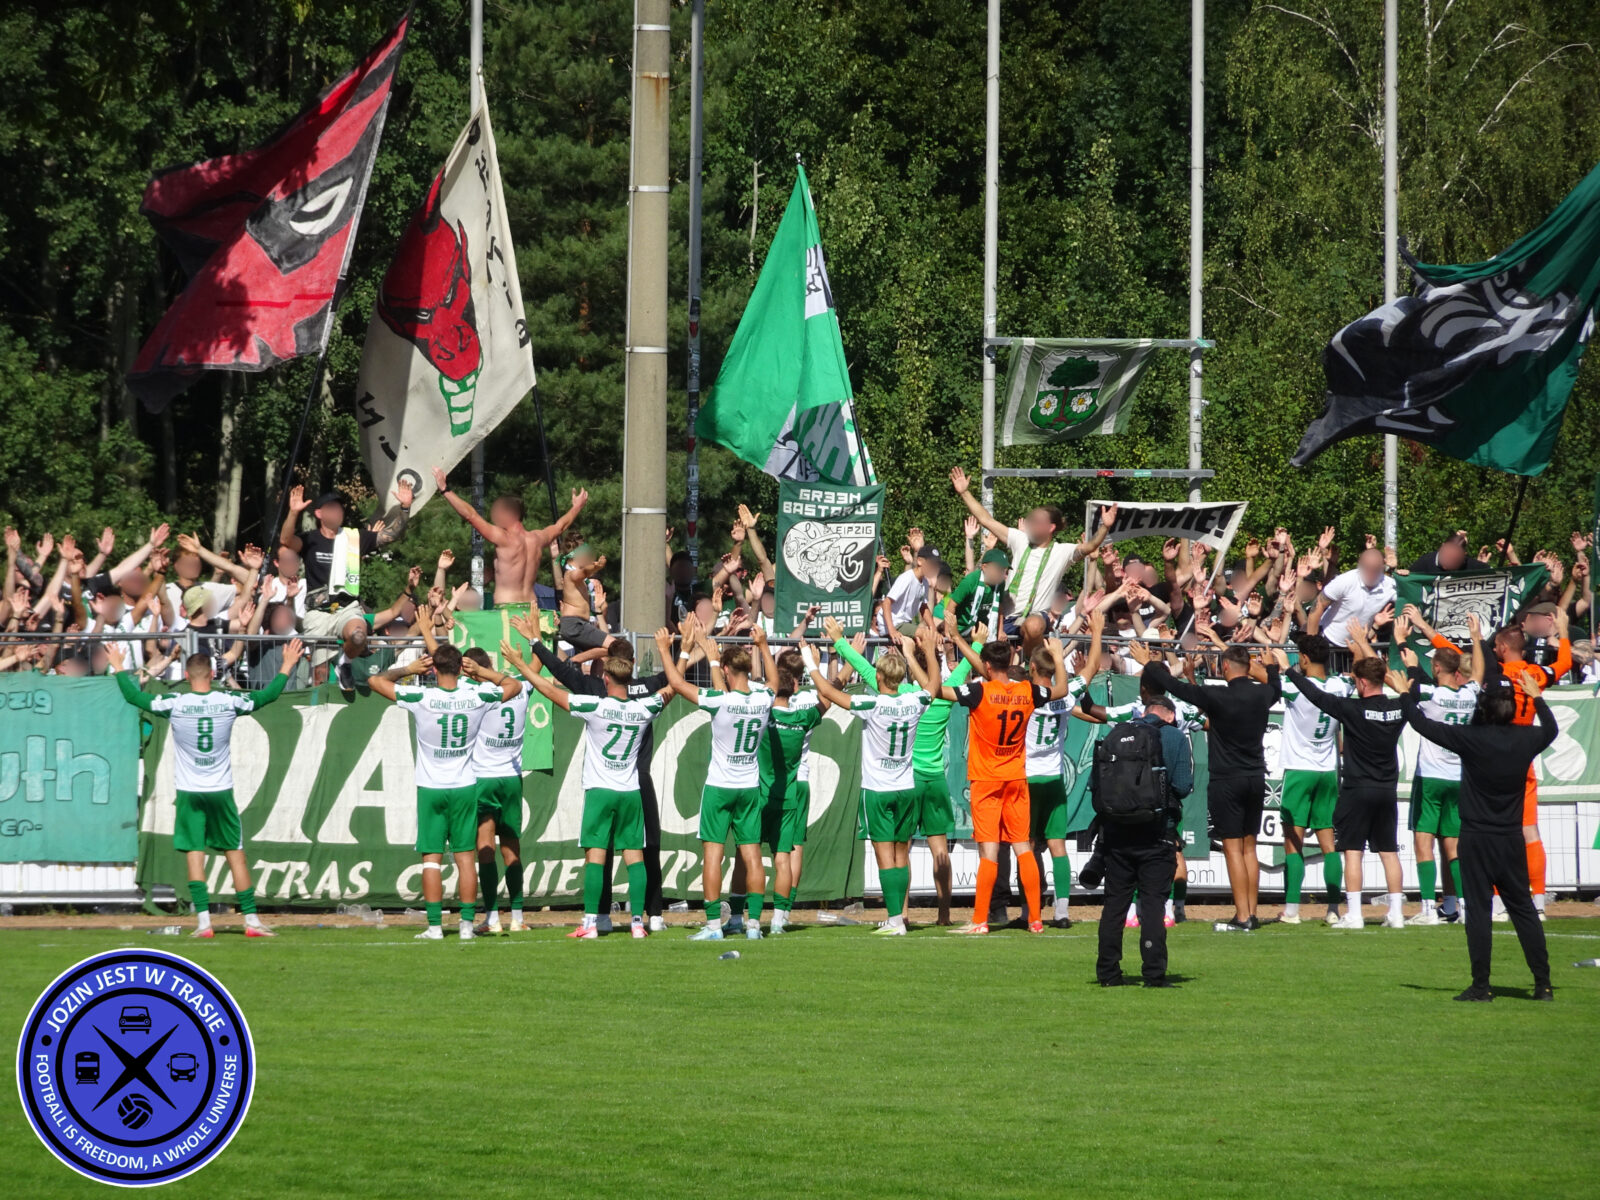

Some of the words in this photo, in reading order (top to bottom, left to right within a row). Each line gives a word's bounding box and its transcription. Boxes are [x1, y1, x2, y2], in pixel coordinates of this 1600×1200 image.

[1446, 580, 1497, 594] SKINS
[197, 717, 213, 752] 8
[437, 713, 468, 748] 19
[498, 707, 515, 739] 3
[733, 718, 762, 754] 16
[887, 721, 909, 757] 11
[997, 710, 1024, 746] 12
[1034, 714, 1060, 745] 13
[1314, 709, 1330, 739] 5
[601, 723, 640, 761] 27
